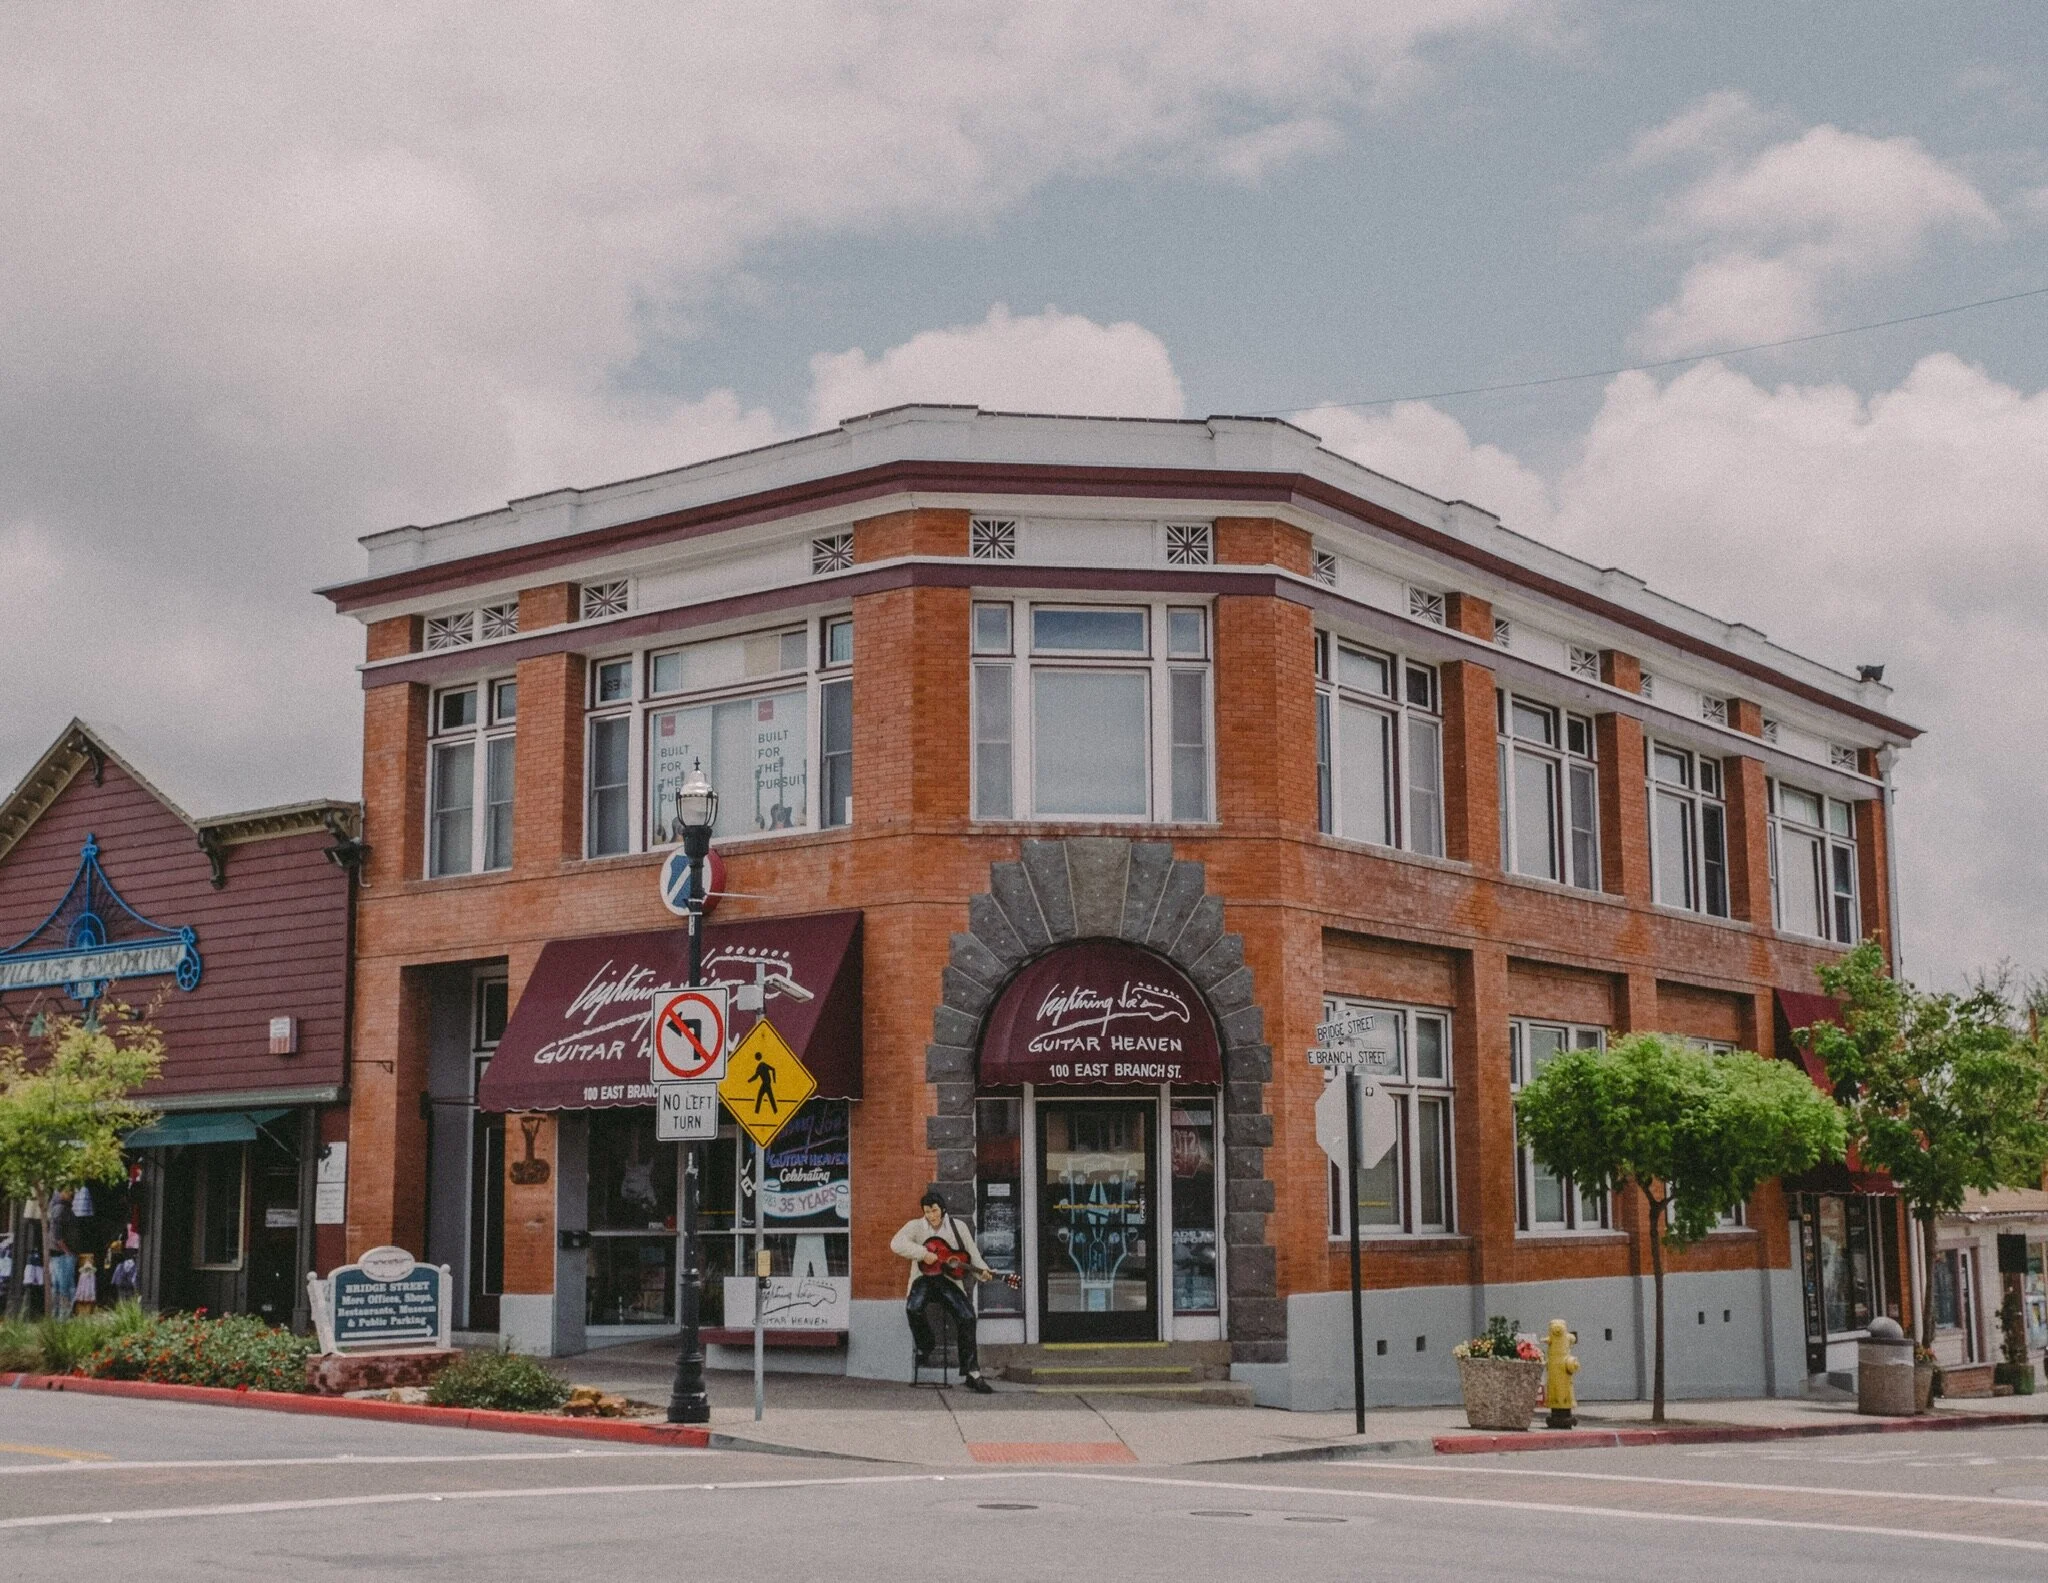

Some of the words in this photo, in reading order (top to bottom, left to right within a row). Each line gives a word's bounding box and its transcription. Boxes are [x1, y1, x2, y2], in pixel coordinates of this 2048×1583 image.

[758, 730, 789, 744] BUILT
[660, 744, 690, 758] BUILT
[758, 746, 781, 759] FOR
[660, 761, 681, 773] FOR
[758, 762, 780, 774] THE
[660, 775, 681, 788] THE
[758, 773, 807, 790] PURSUIT
[1316, 1022, 1345, 1042] BRIDGE
[1347, 1016, 1375, 1034] STREET
[1028, 1036, 1101, 1053] GUITAR
[1111, 1035, 1183, 1052] HEAVEN
[534, 1040, 624, 1064] GUITAR
[1308, 1051, 1314, 1064] E
[1316, 1051, 1353, 1064] BRANCH
[1358, 1051, 1386, 1065] STREET
[1049, 1064, 1069, 1078] 100
[1075, 1063, 1109, 1077] EAST
[1115, 1063, 1165, 1078] BRANCH
[1167, 1064, 1182, 1079] ST.
[583, 1086, 598, 1101] 100
[601, 1085, 625, 1100] EAST
[627, 1083, 659, 1098] BRANC
[663, 1093, 680, 1111] NO
[686, 1095, 712, 1110] LEFT
[673, 1115, 702, 1130] TURN
[780, 1167, 830, 1184] Celebrating
[778, 1197, 795, 1213] 35
[798, 1187, 837, 1211] YEARS
[345, 1283, 387, 1294] BRIDGE
[389, 1281, 430, 1292] STREET
[341, 1295, 365, 1306] More
[399, 1305, 437, 1314] Museum
[347, 1319, 356, 1328] &
[358, 1317, 388, 1328] Public
[390, 1315, 428, 1327] Parking
[792, 1316, 828, 1326] HEAVEN
